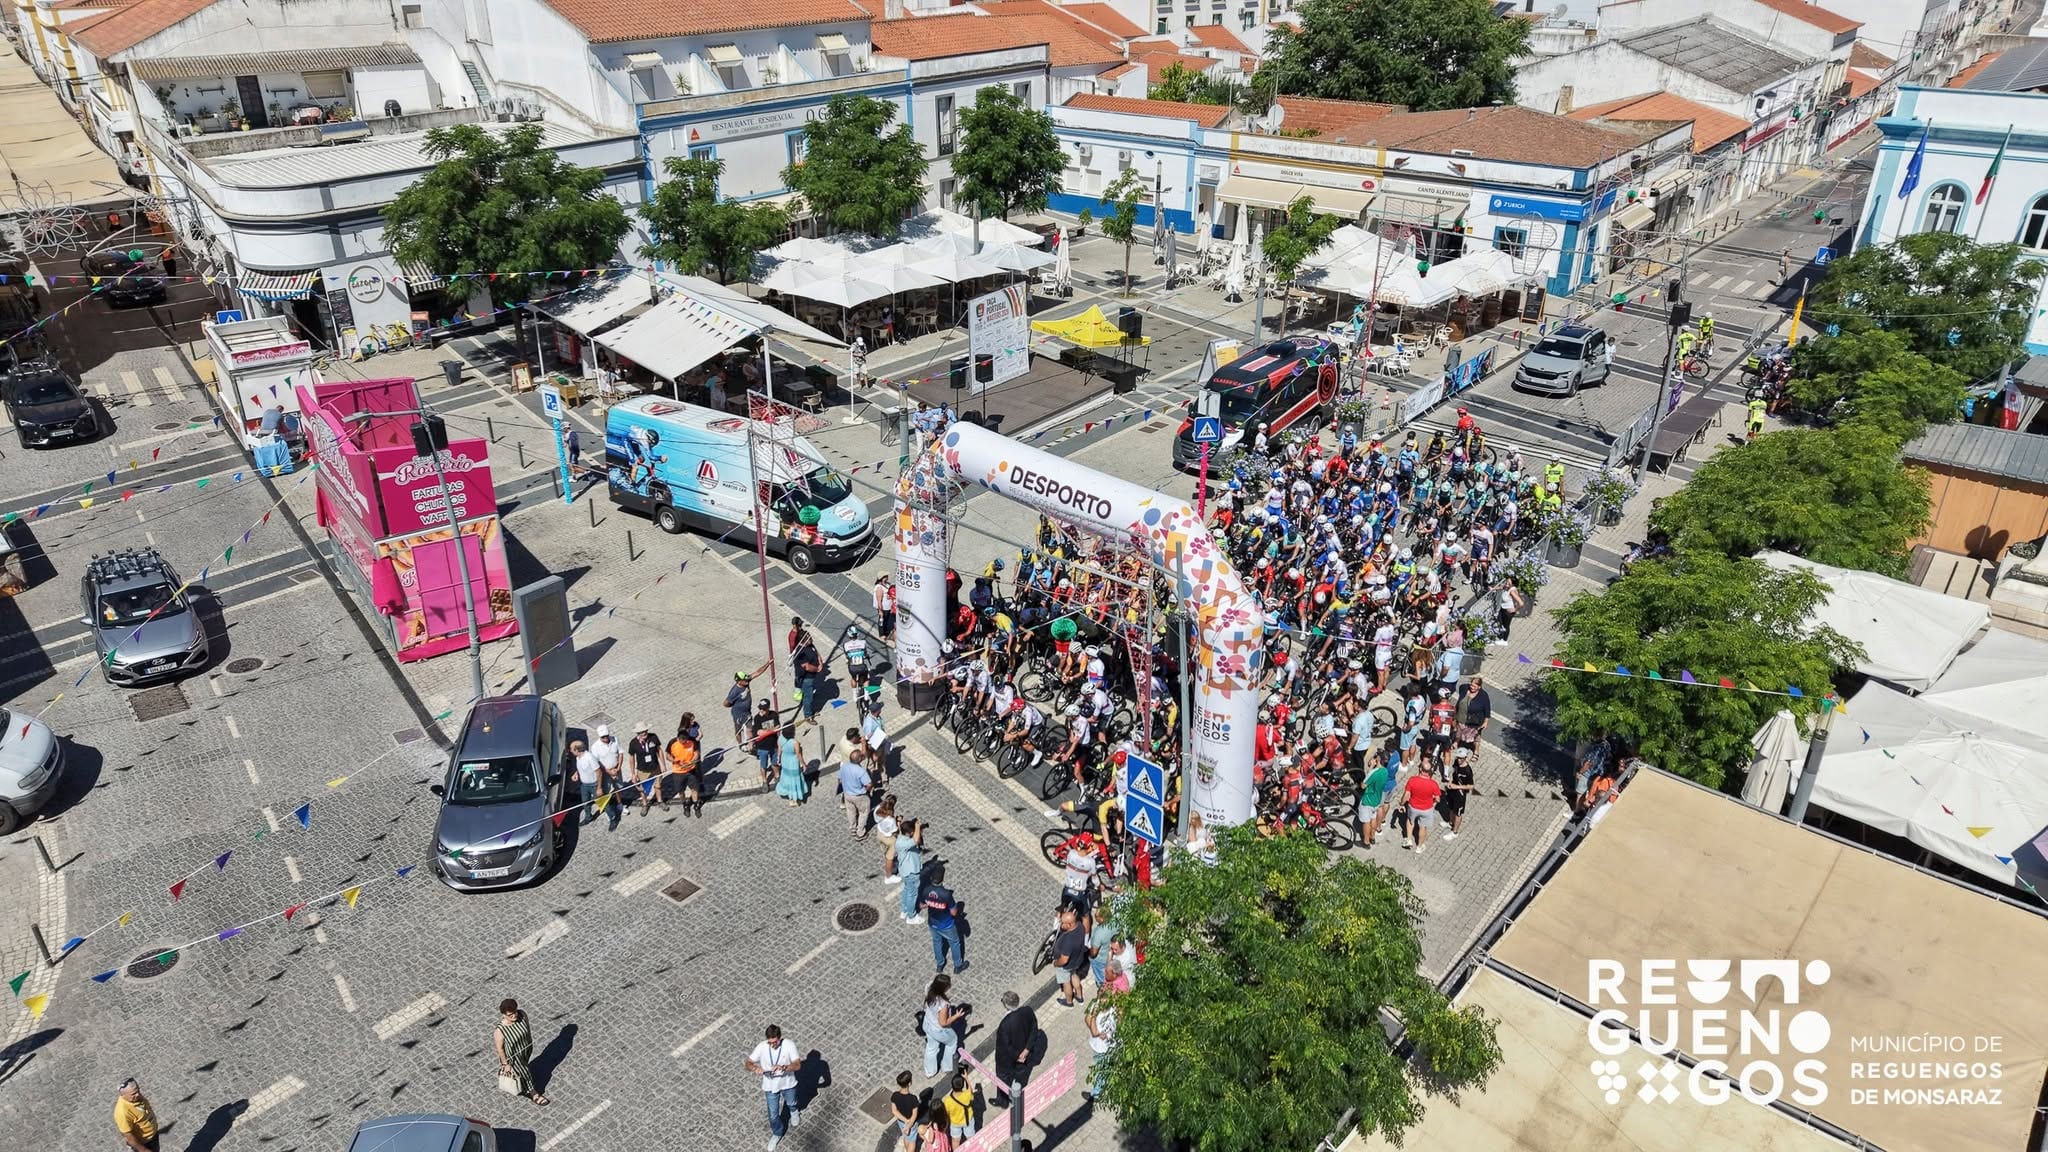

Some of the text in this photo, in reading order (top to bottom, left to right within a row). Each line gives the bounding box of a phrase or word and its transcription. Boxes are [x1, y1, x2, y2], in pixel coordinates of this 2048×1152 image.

[712, 118, 754, 132] RESTAURANTE
[758, 112, 795, 125] RESIDENCIAL
[1417, 186, 1469, 198] CANTO ALENTEJANO
[413, 481, 464, 499] FARTUAS
[1010, 465, 1112, 519] DESPORTO
[415, 494, 466, 511] CHUROS
[421, 508, 465, 523] WAFFES
[1202, 728, 1230, 742] GOS
